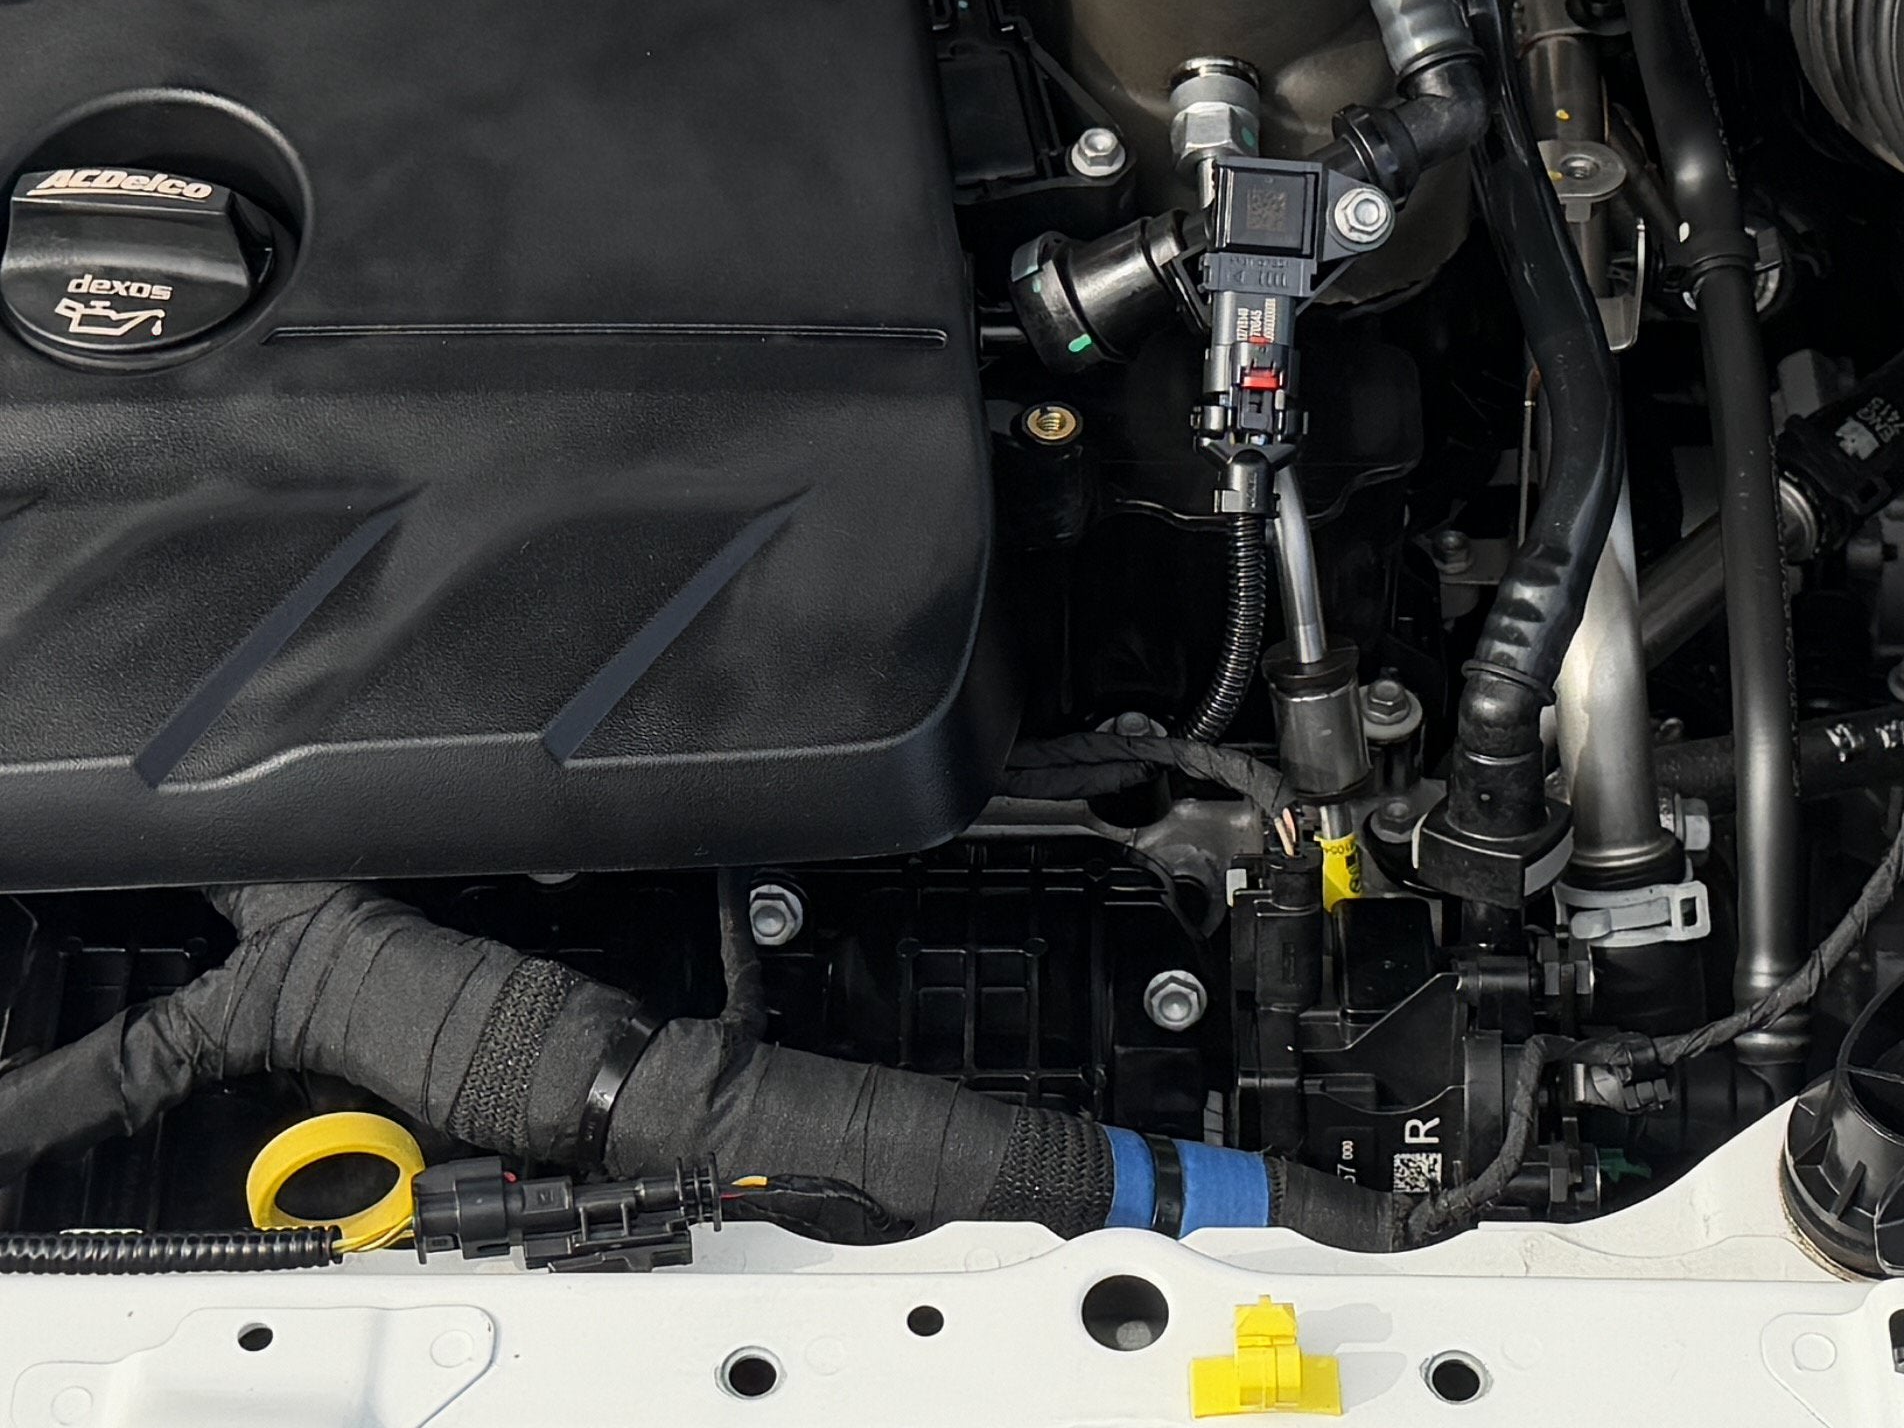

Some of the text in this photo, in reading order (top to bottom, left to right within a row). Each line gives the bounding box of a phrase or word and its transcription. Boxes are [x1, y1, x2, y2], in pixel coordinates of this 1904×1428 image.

[35, 169, 214, 200] ACDelco
[67, 274, 173, 301] dexos
[1404, 1116, 1441, 1144] R
